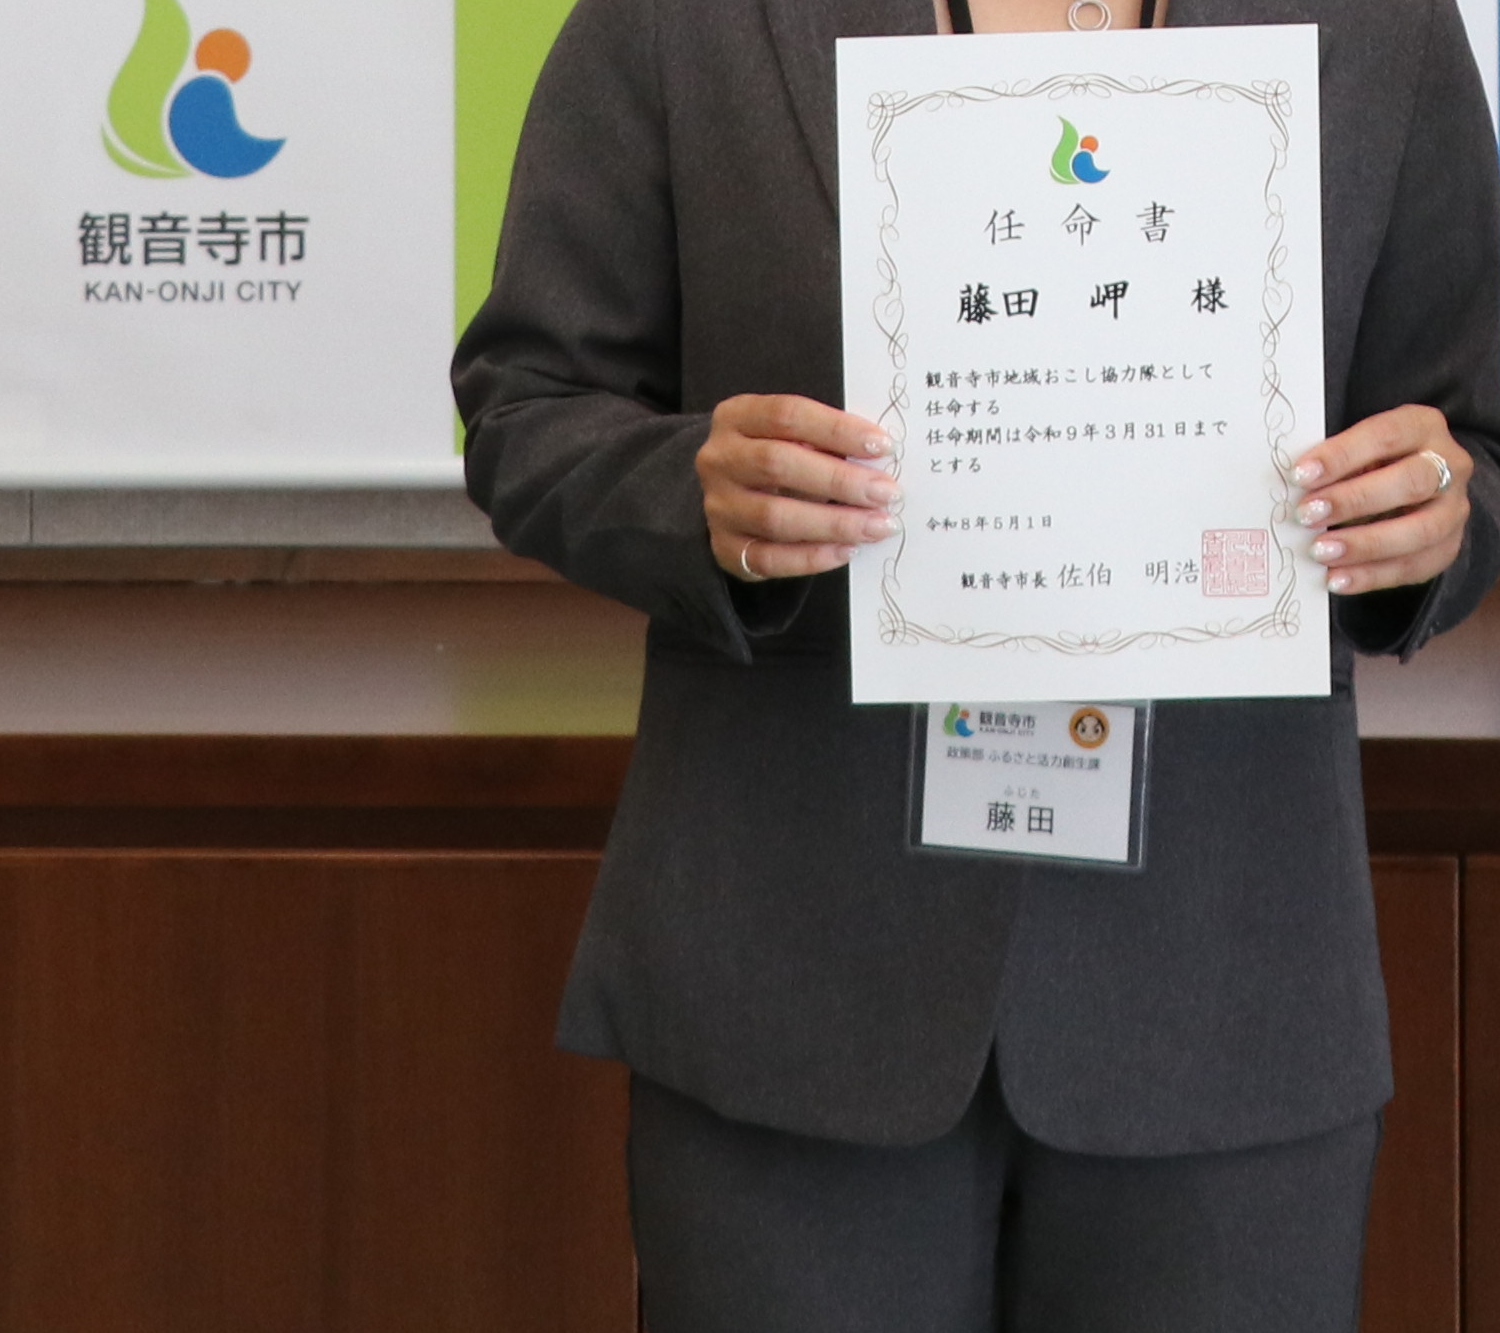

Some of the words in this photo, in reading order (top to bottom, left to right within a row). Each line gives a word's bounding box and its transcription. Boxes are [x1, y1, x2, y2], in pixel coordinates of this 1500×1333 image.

[986, 202, 1174, 245] 任命書
[79, 211, 309, 266] 観音寺市
[85, 281, 224, 302] KAN-ONJI
[237, 281, 300, 301] CITY
[958, 283, 1038, 324] 藤田
[1091, 281, 1128, 319] 岬
[1192, 277, 1227, 313] 様
[926, 364, 1211, 388] 観音寺市地域おこし協力隊として
[926, 399, 999, 416] 任命する
[931, 458, 980, 472] とする
[962, 572, 1047, 589] 観音寺市長
[1060, 564, 1110, 588] 佐伯
[1146, 560, 1197, 584] 明浩
[980, 711, 1035, 728] 観音寺市
[986, 801, 1054, 835] 藤田
